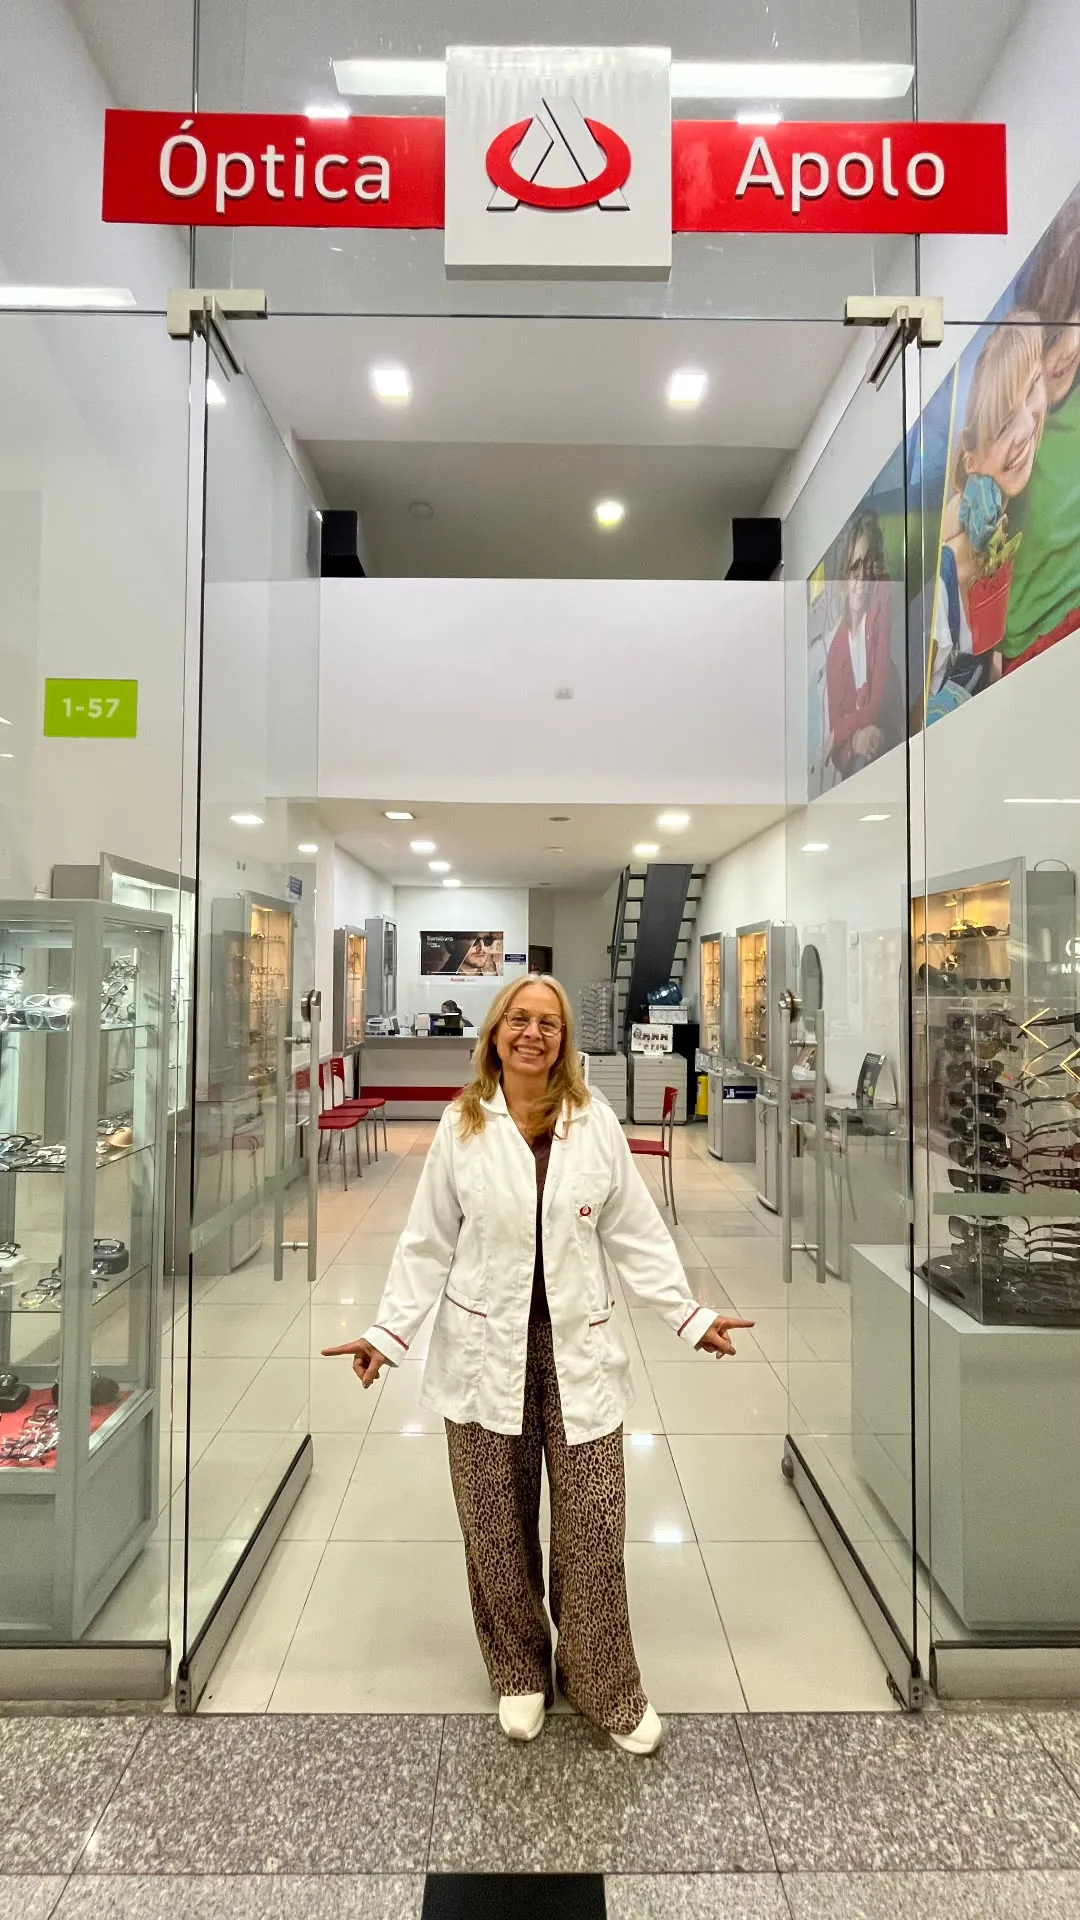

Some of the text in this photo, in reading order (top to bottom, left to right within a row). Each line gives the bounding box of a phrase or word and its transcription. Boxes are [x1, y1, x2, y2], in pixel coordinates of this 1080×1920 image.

[159, 119, 946, 214] Óptica Apolo
[62, 698, 120, 719] 1-57
